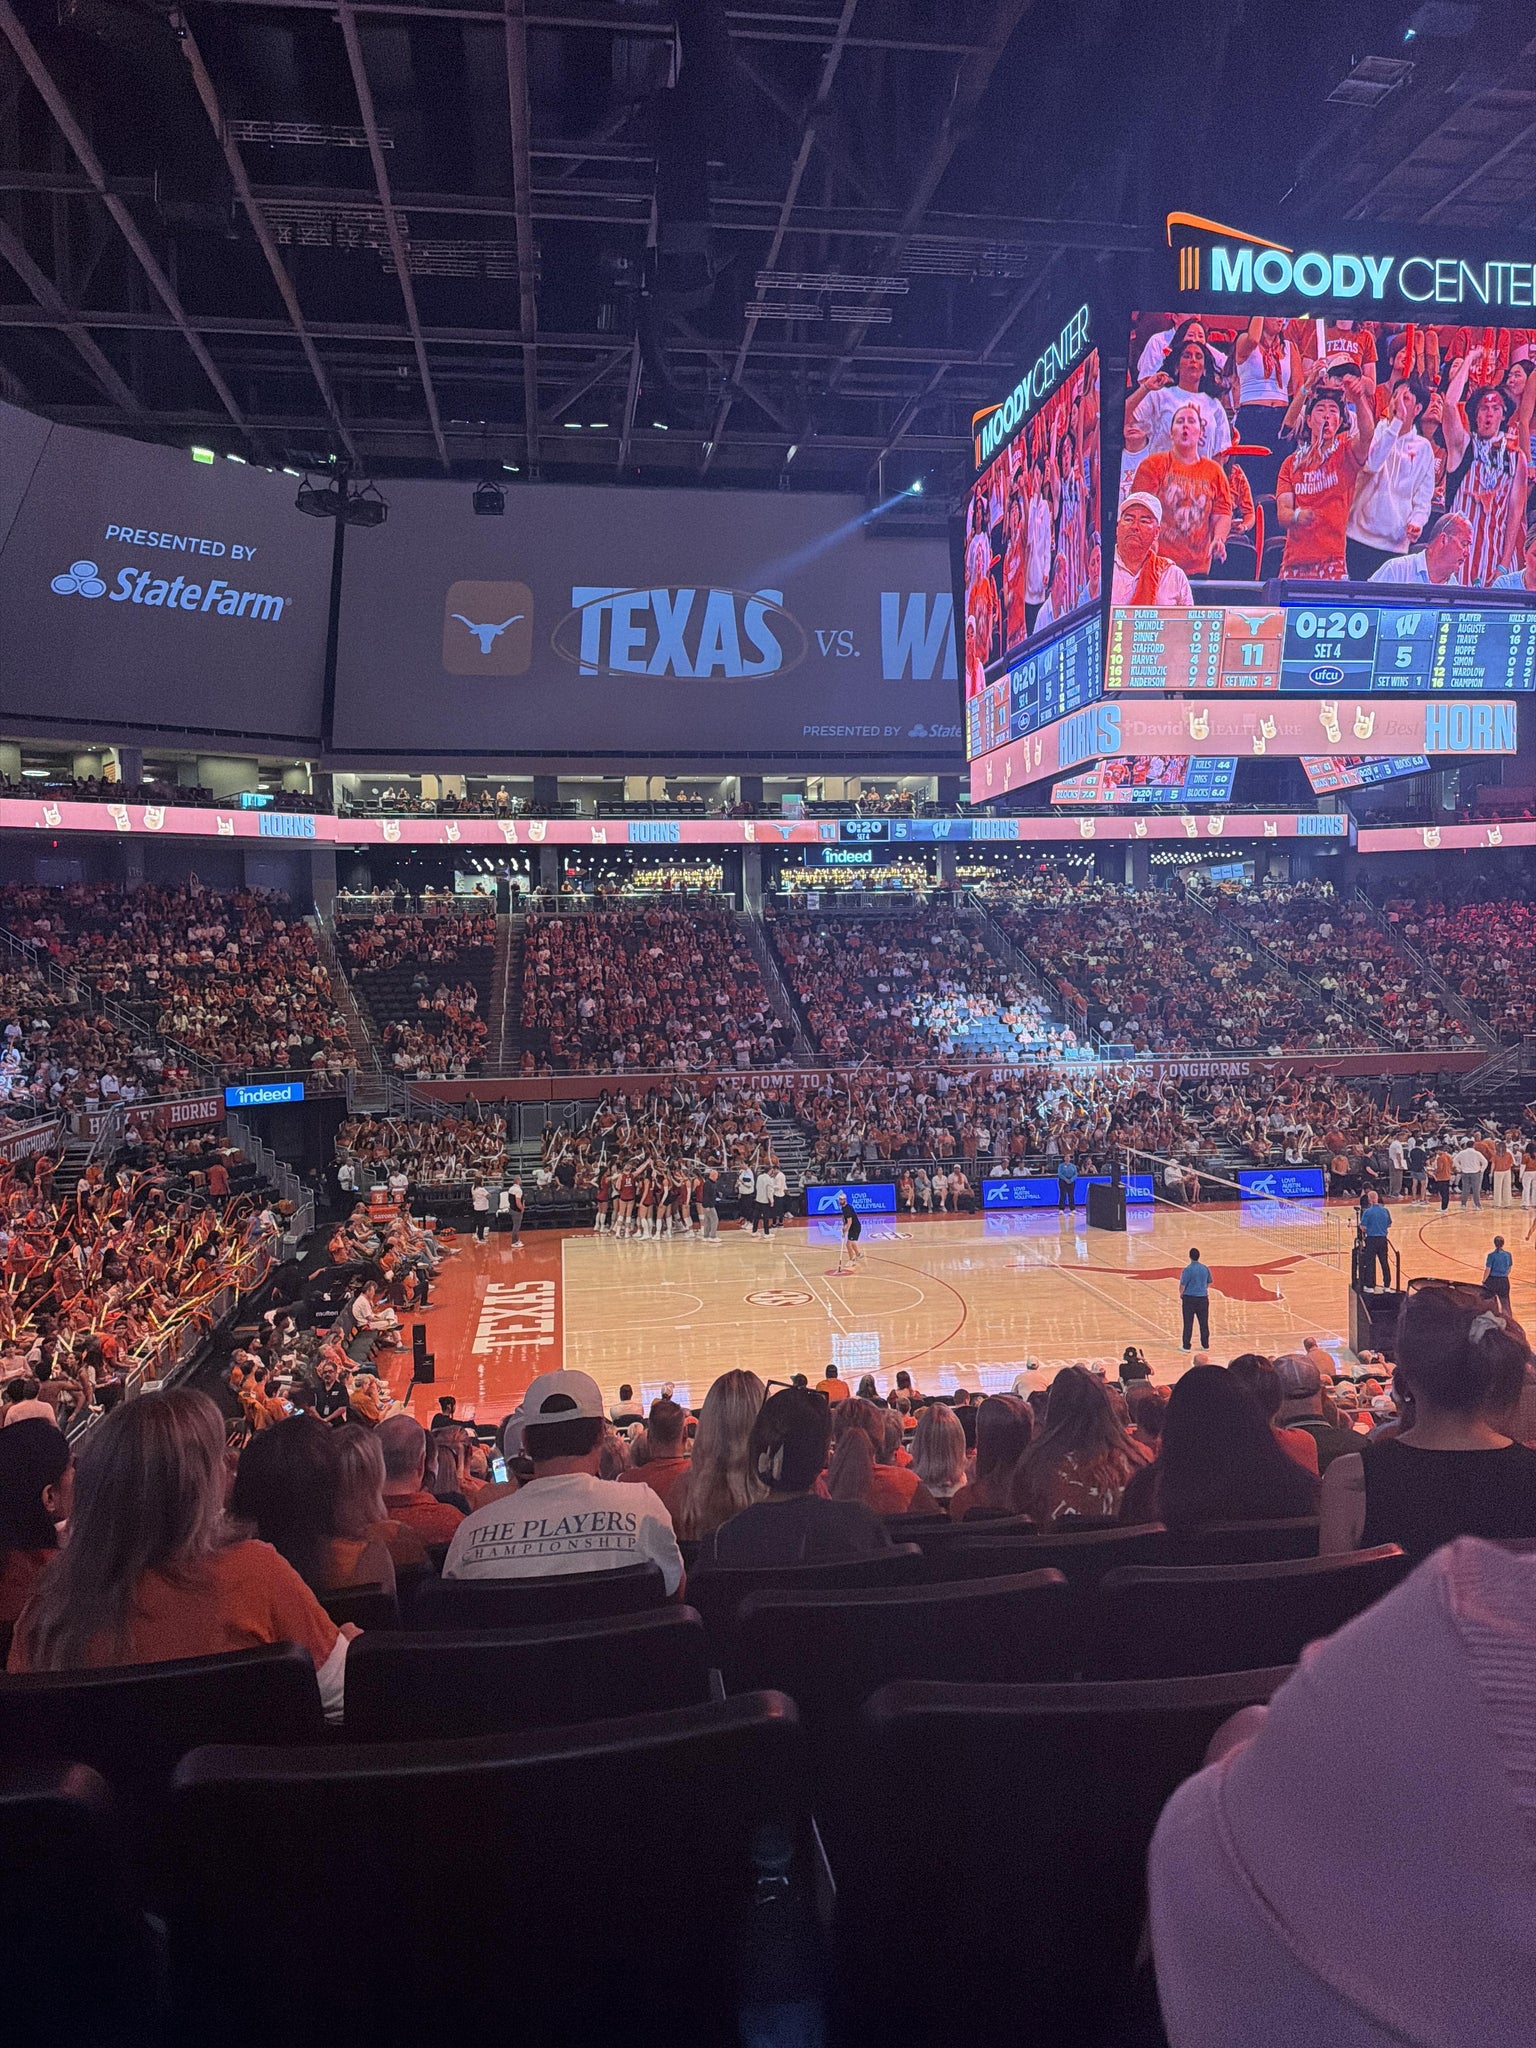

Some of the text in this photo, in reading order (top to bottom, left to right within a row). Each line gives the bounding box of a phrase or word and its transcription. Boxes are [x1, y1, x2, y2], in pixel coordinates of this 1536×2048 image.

[1211, 247, 1536, 306] MOODY CENTE
[1327, 338, 1358, 353] TEXAS
[982, 304, 1089, 460] MOODY CENTER
[105, 525, 257, 561] PRESENTED BY
[1115, 610, 1223, 618] NO. PLAYER KILLS DIGS
[1441, 614, 1452, 622] NO.
[1459, 614, 1481, 622] PLAYER
[1509, 614, 1525, 622] KILLS
[1116, 621, 1220, 630] 1 SWINDLE 0 0
[1296, 611, 1369, 639] 0:20
[1441, 624, 1536, 633] 4 AUGUSTE 0 0
[572, 587, 783, 678] TEXAS
[815, 629, 860, 658] VS.
[1114, 632, 1220, 642] 3 BINNEY 0 18
[1439, 635, 1536, 644] 5 TRAVIS 16 2
[1113, 644, 1219, 653] 4 STAFFORD 12 10
[1241, 644, 1264, 666] 11
[1314, 644, 1341, 658] SET 4
[1438, 646, 1534, 655] 6 HOPPE 0 0
[1110, 655, 1217, 664] 10 HARVEY 4 0
[1395, 646, 1412, 668] 5
[1437, 657, 1532, 666] 7 SIMON 0 5
[1013, 662, 1035, 694] 0:20
[1109, 666, 1122, 676] 16
[1189, 667, 1198, 676] 0
[1208, 667, 1216, 676] 0
[1315, 669, 1338, 680] ufcu
[1434, 668, 1531, 677] 12 WARDLOW 5 2
[1108, 678, 1214, 687] 22 ANDERSON 7 6
[1225, 676, 1272, 686] SET WINS 2
[1378, 677, 1421, 686] SET WINS 1
[1432, 678, 1528, 687] 16 CHAMPION 4 1
[1045, 681, 1052, 701] 5
[803, 725, 880, 737] PRESENTED
[884, 727, 901, 737] BY
[1385, 721, 1418, 736] Best
[1426, 704, 1516, 750] HORN
[1059, 704, 1121, 769] HORNS
[1195, 761, 1230, 769] KILLS 44
[1193, 775, 1207, 783] DIGS
[1056, 790, 1095, 798] BLOCKS 7.0
[1104, 791, 1114, 799] 11
[1133, 789, 1150, 798] 0:20
[1170, 790, 1178, 798] 5
[1187, 789, 1208, 797] BLOCKS
[259, 814, 315, 837] HORNS
[628, 822, 680, 842] HORNS
[820, 824, 835, 838] 11
[846, 822, 881, 834] 0:20
[895, 824, 906, 838] 5
[972, 820, 1019, 839] HORNS
[1297, 815, 1344, 836] HORNS
[822, 848, 871, 863] indeed
[1066, 1066, 1097, 1079] THE
[1160, 1062, 1250, 1079] LONGHORNS
[717, 1074, 794, 1089] WELCOME
[801, 1074, 819, 1088] TO
[235, 1088, 291, 1103] indeed
[171, 1101, 217, 1122] HORNS
[10, 1129, 55, 1162] LONGHORNS
[472, 1281, 555, 1354] TEXAS
[469, 1511, 637, 1546] THE PLAYERS
[462, 1537, 637, 1562] CHAMPIONSHIP
